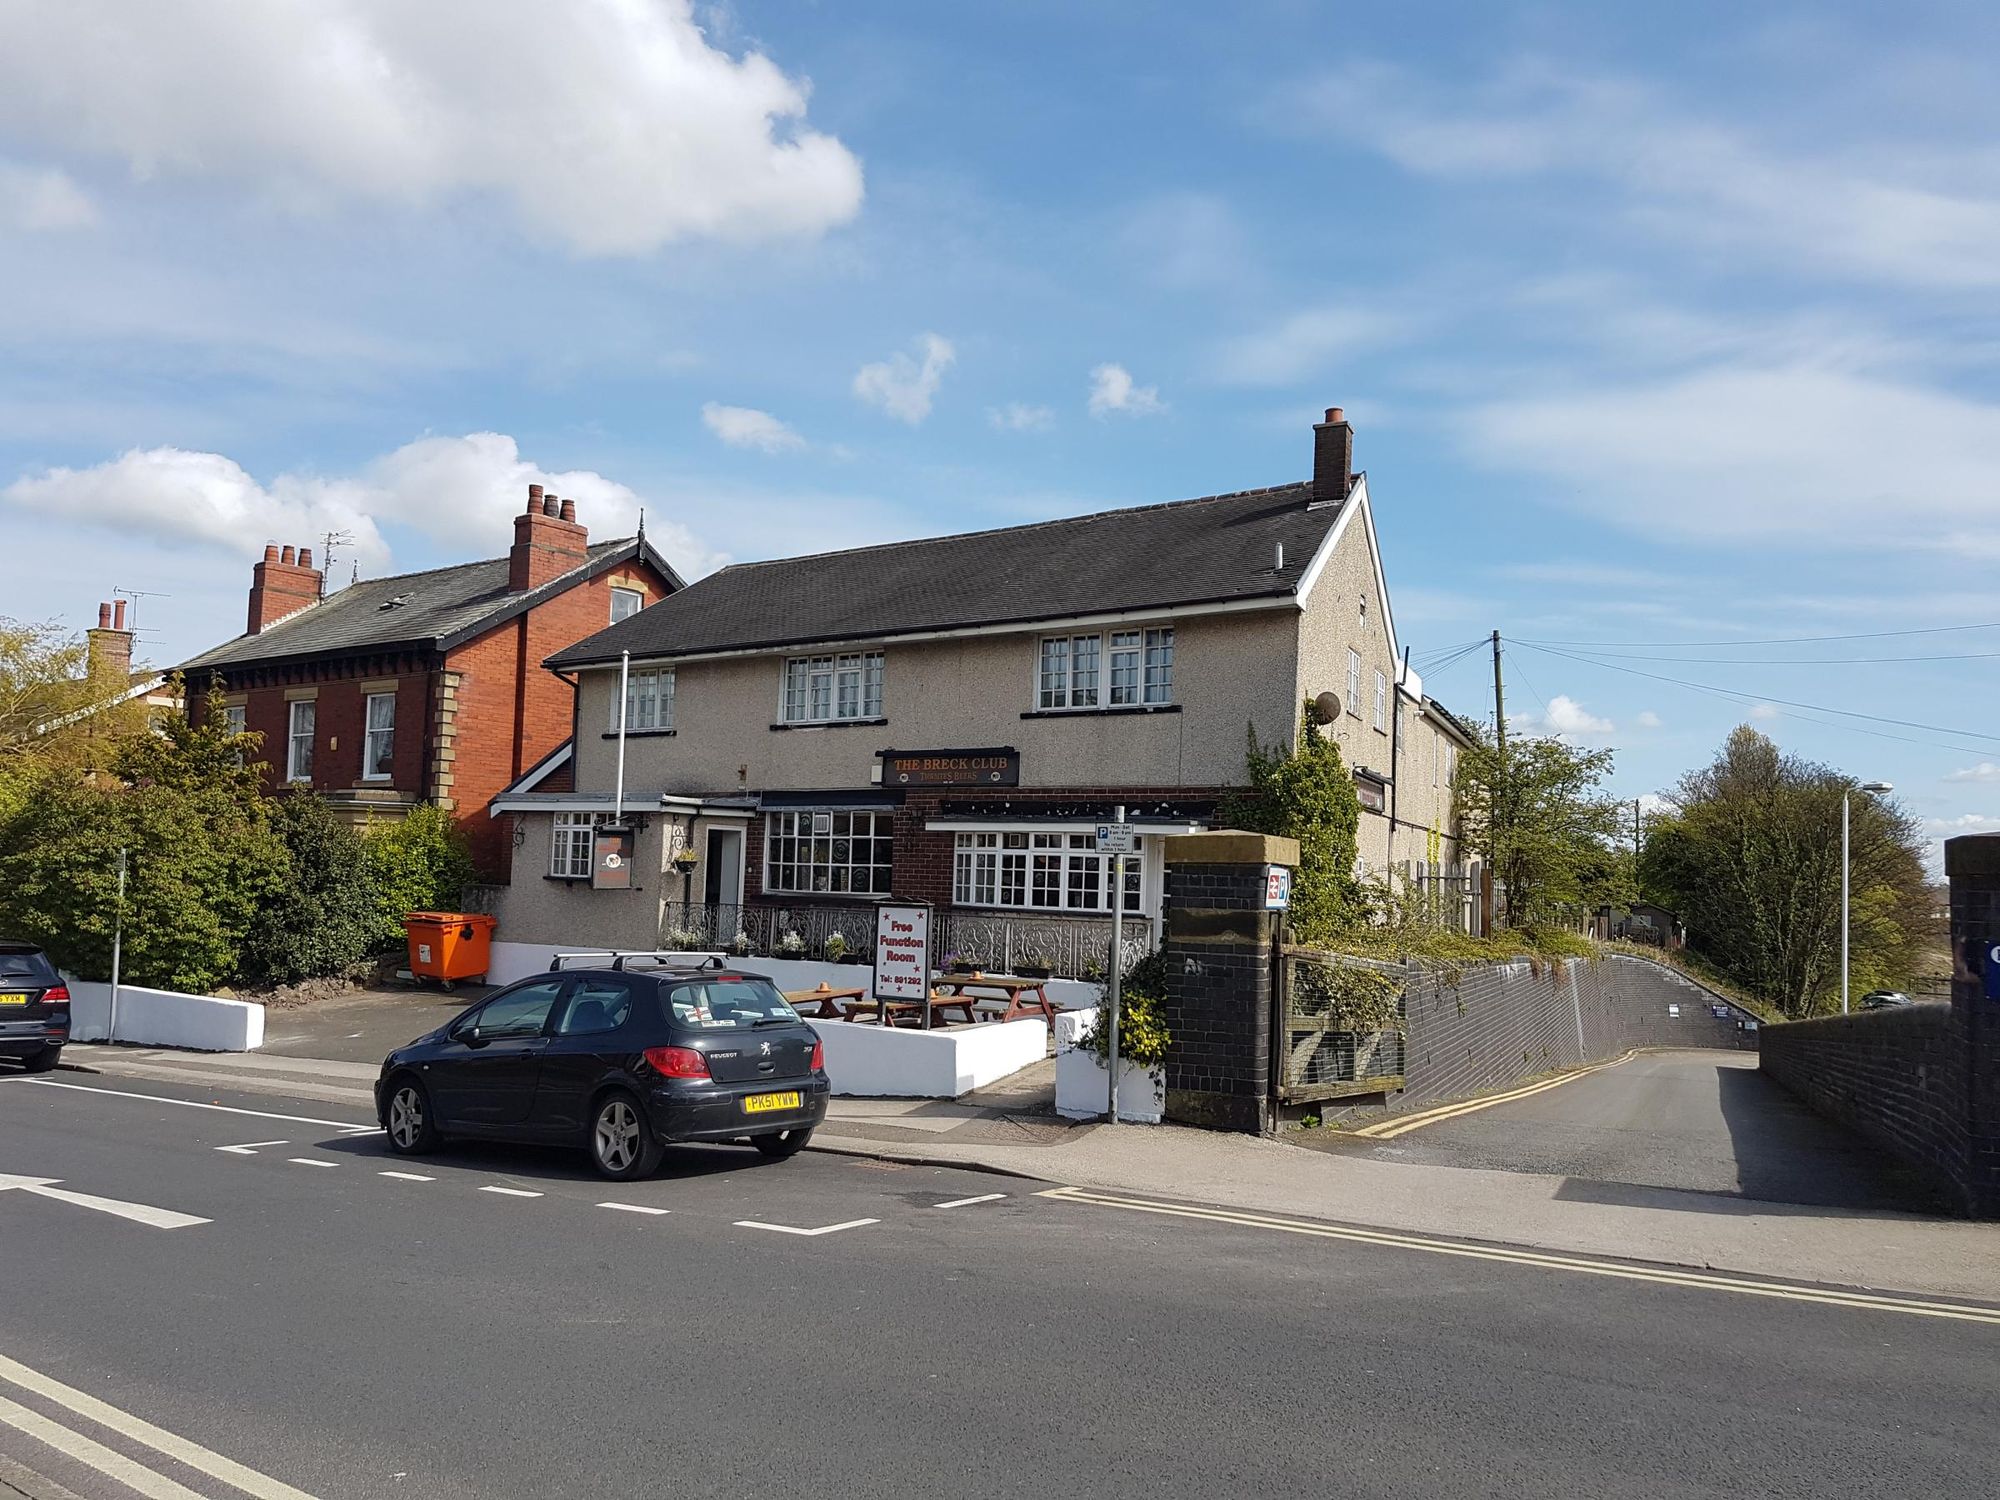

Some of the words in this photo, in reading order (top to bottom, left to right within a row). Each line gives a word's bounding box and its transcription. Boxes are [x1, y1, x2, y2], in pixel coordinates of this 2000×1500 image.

[894, 759, 920, 771] THE
[924, 758, 969, 770] BRECK
[971, 757, 1008, 769] CLUB
[891, 920, 913, 932] Free
[880, 935, 924, 948] Function
[886, 950, 916, 963] Room
[880, 974, 893, 983] Tel:
[751, 1094, 775, 1109] PK51
